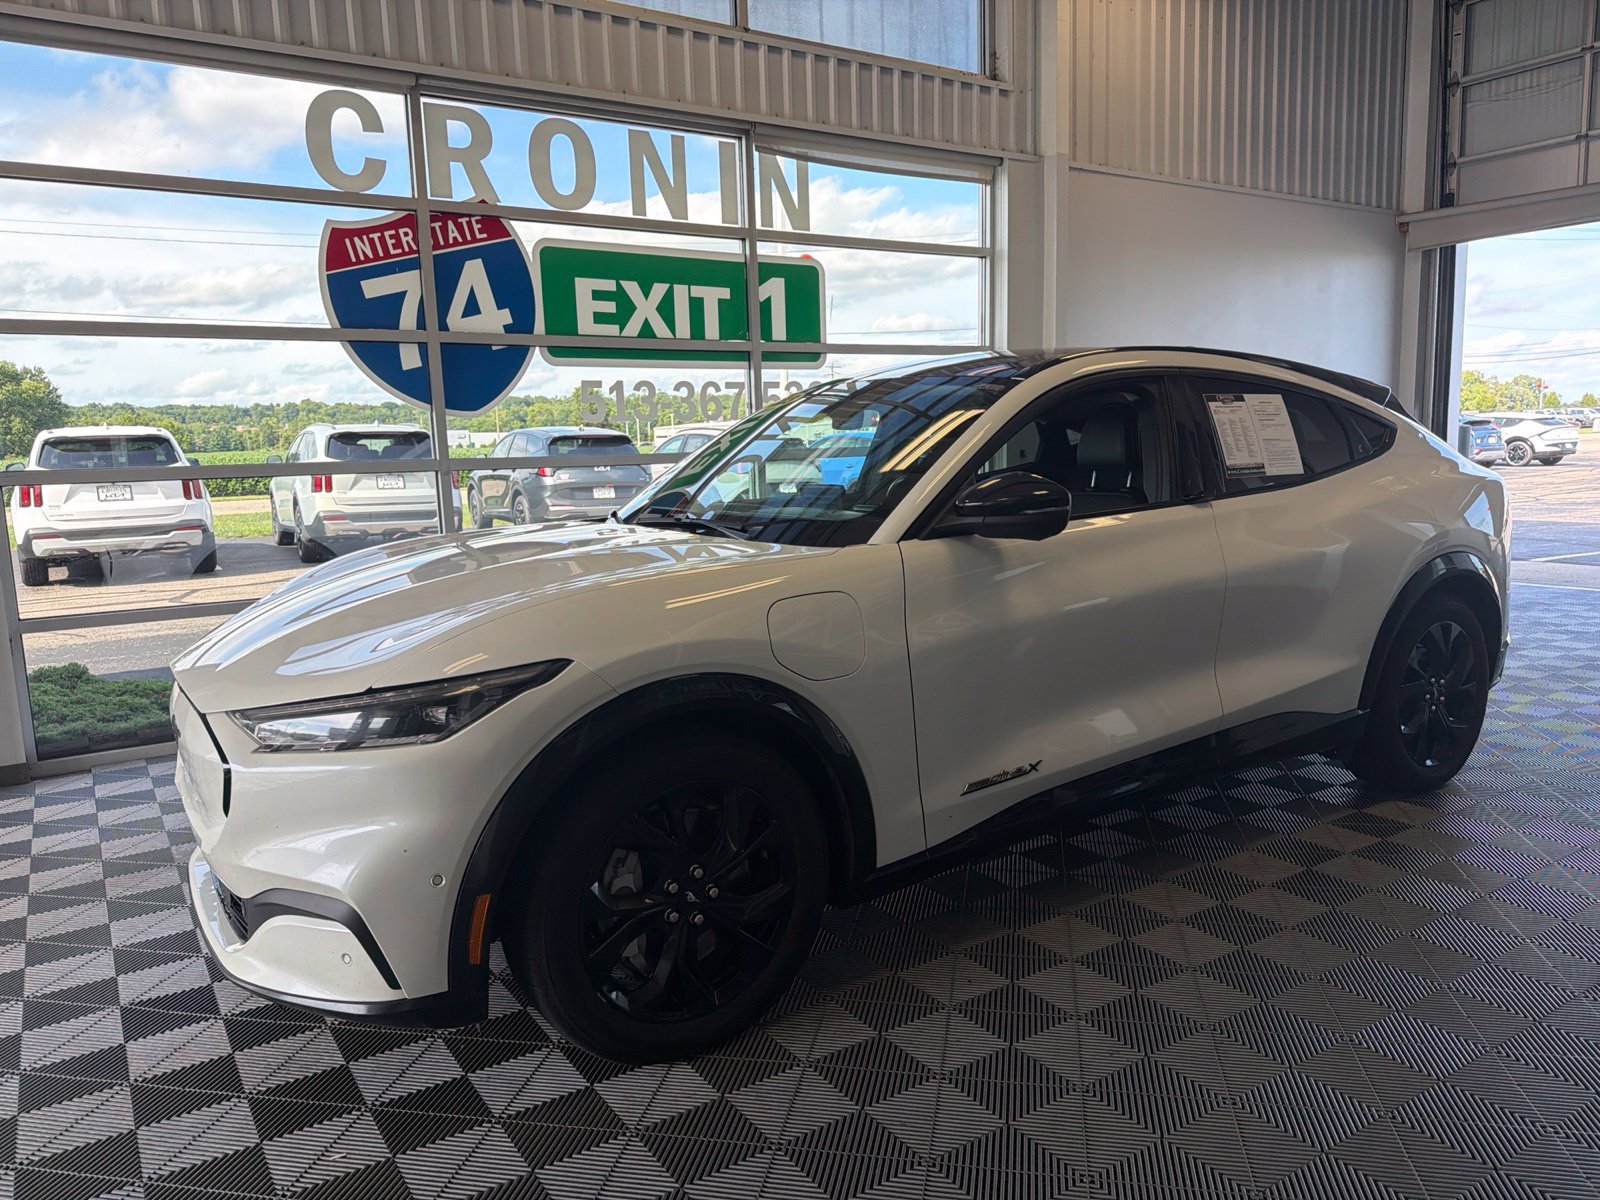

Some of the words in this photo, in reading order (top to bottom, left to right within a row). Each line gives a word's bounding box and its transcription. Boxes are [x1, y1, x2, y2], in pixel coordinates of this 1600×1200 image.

[305, 89, 811, 232] CRONIN
[345, 216, 488, 263] INTERTATE
[360, 258, 513, 371] 74
[574, 277, 731, 340] EXIT
[758, 277, 787, 341] 1
